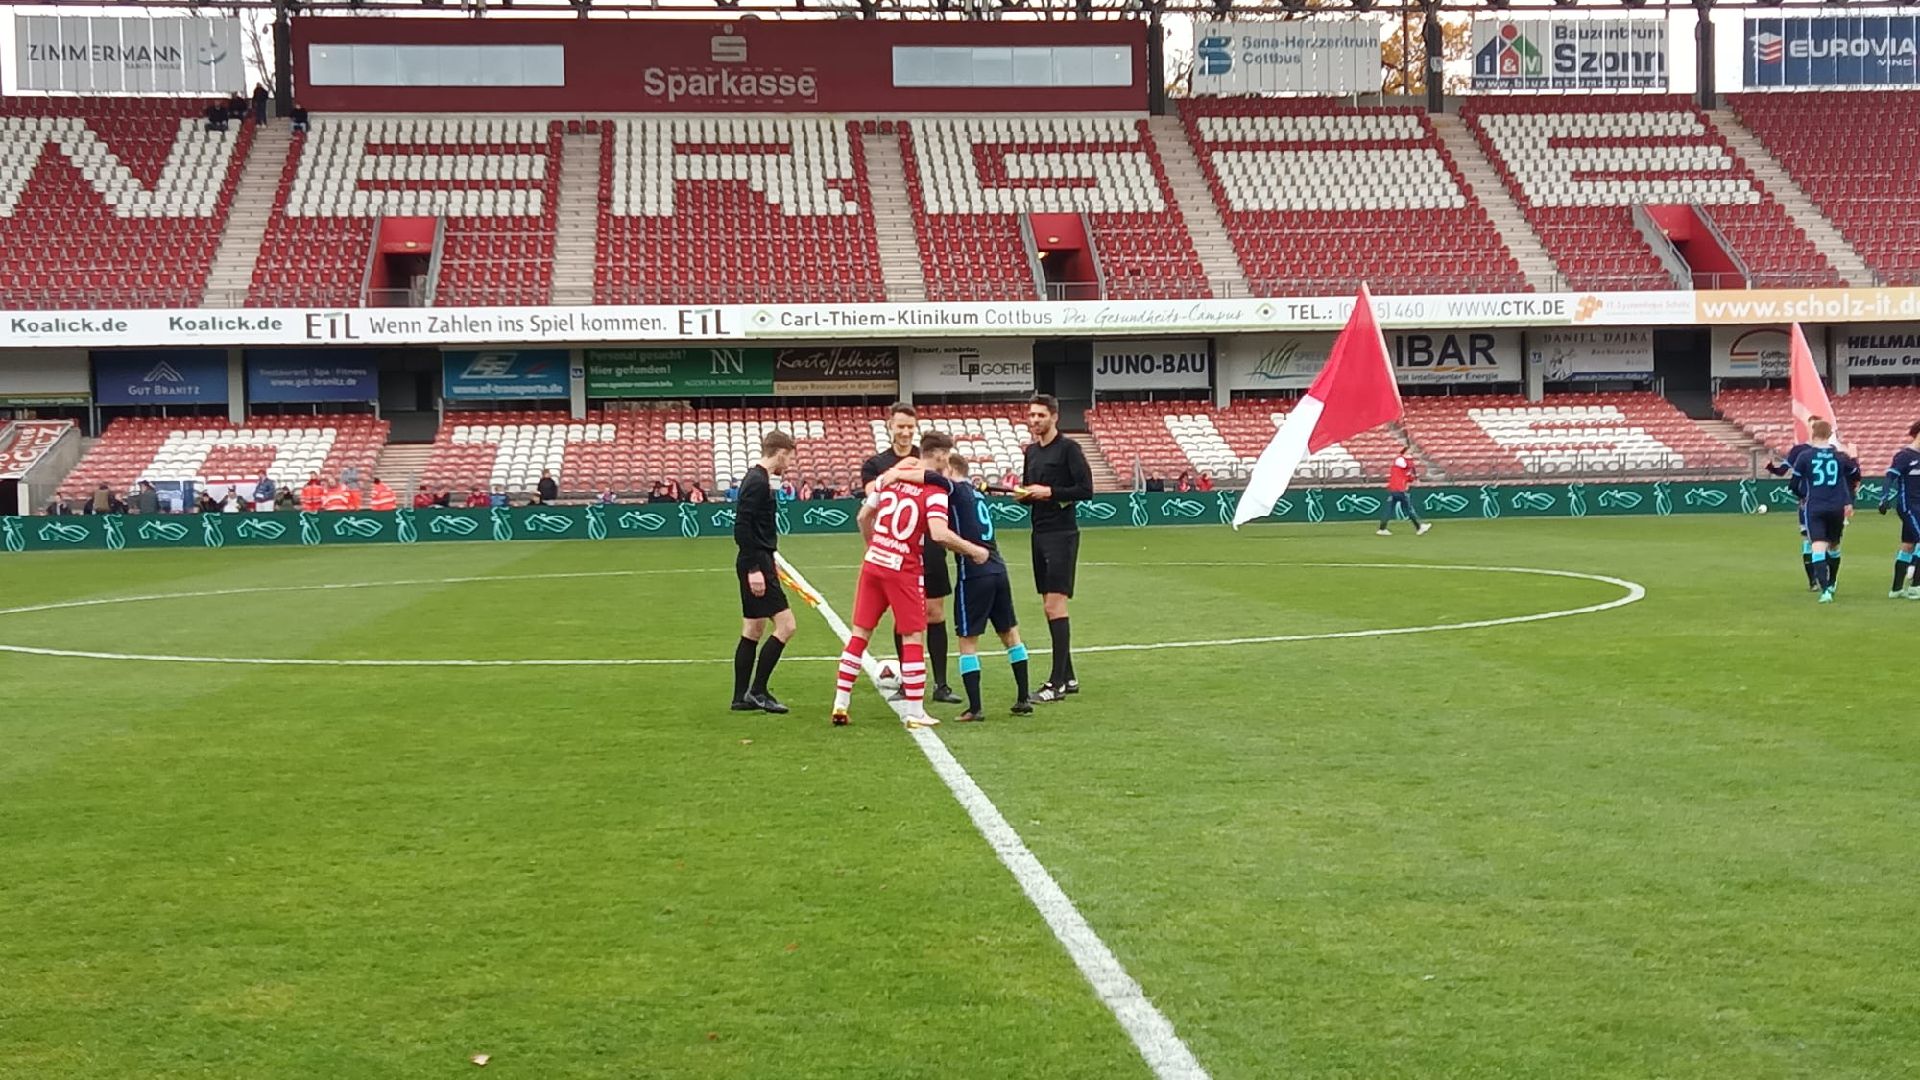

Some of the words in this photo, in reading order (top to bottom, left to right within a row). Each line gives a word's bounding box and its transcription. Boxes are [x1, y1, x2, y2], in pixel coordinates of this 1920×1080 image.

[1242, 35, 1378, 50] Sana-Herzzentrum
[1555, 26, 1664, 40] Bauzentrum
[27, 44, 182, 62] ZIMMERMANN
[1789, 37, 1915, 58] EUROVIA
[1242, 52, 1301, 65] Cottbus
[1554, 43, 1665, 73] Szonn
[644, 68, 817, 103] Sparkasse
[781, 310, 978, 326] Carl-Thiem-Klinikum
[985, 308, 1052, 325] Cottbus
[1062, 306, 1088, 324] Der
[1094, 303, 1242, 328] Gesundheits-Campus
[1288, 304, 1333, 320] TEL.:
[1395, 302, 1425, 318] 460
[1447, 300, 1565, 317] WWW.CTK.DE
[11, 318, 128, 333] Koalick.de
[169, 316, 283, 331] Koalick.de
[305, 312, 360, 340] ETL
[370, 316, 421, 334] Wenn
[428, 315, 492, 334] Zahlen
[498, 314, 525, 332] ins
[530, 313, 574, 336] Spiel
[581, 313, 667, 332] kommen.
[678, 309, 730, 336] ETL
[1544, 333, 1598, 344] DANIEL
[1603, 332, 1649, 344] DAJKA
[1395, 333, 1497, 367] IBAR
[981, 362, 1032, 375] GOETHE
[1096, 353, 1206, 375] JUNO-BAU
[1848, 354, 1897, 367] Tiefbau
[589, 365, 613, 375] Hier
[615, 364, 672, 377] gefunden!
[128, 385, 152, 396] GUT
[155, 384, 200, 395] BRANITZ
[1811, 459, 1839, 486] 39
[874, 490, 919, 541] 20
[977, 499, 994, 541] 9
